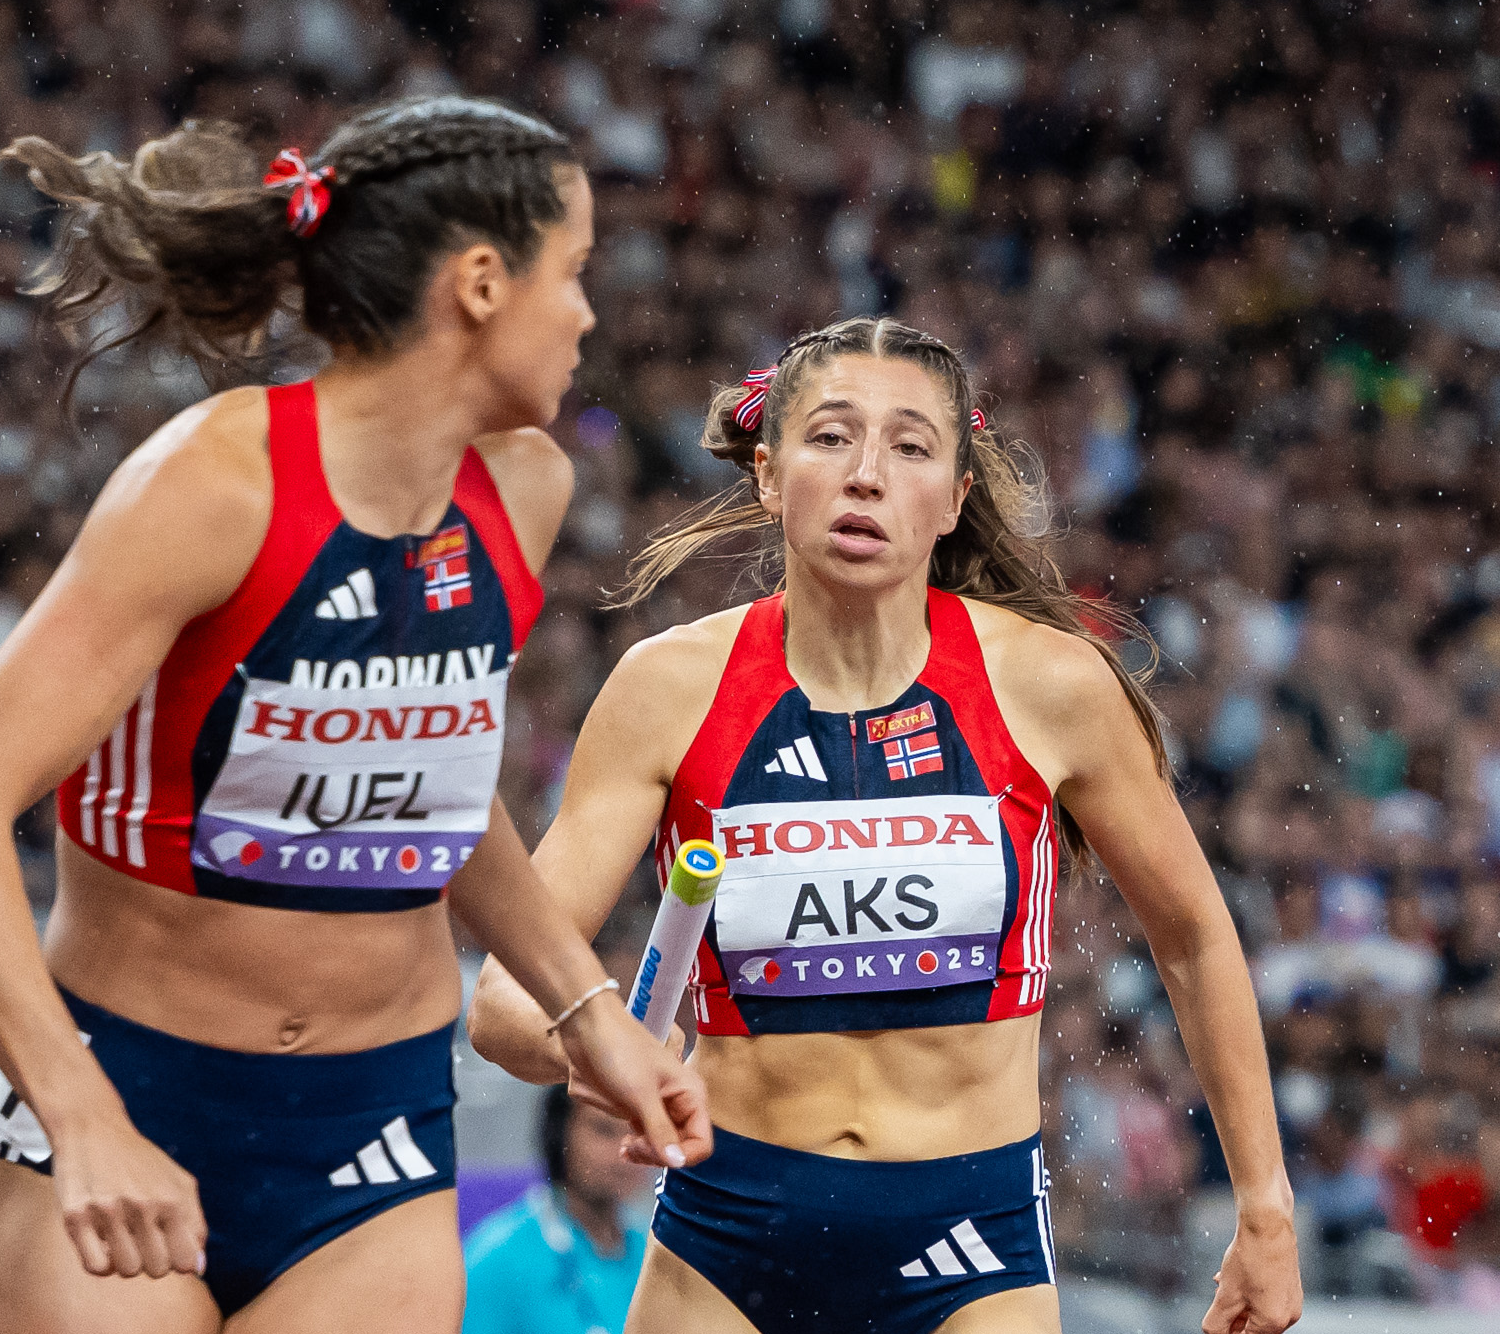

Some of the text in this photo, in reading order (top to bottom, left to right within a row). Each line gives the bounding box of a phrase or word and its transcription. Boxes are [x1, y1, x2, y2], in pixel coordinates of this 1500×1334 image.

[244, 698, 498, 744] HONDA
[888, 710, 930, 733] EXTRA
[280, 772, 432, 829] IUEL
[719, 813, 994, 859] HONDA
[785, 874, 939, 941] AKS
[948, 945, 986, 969] 25
